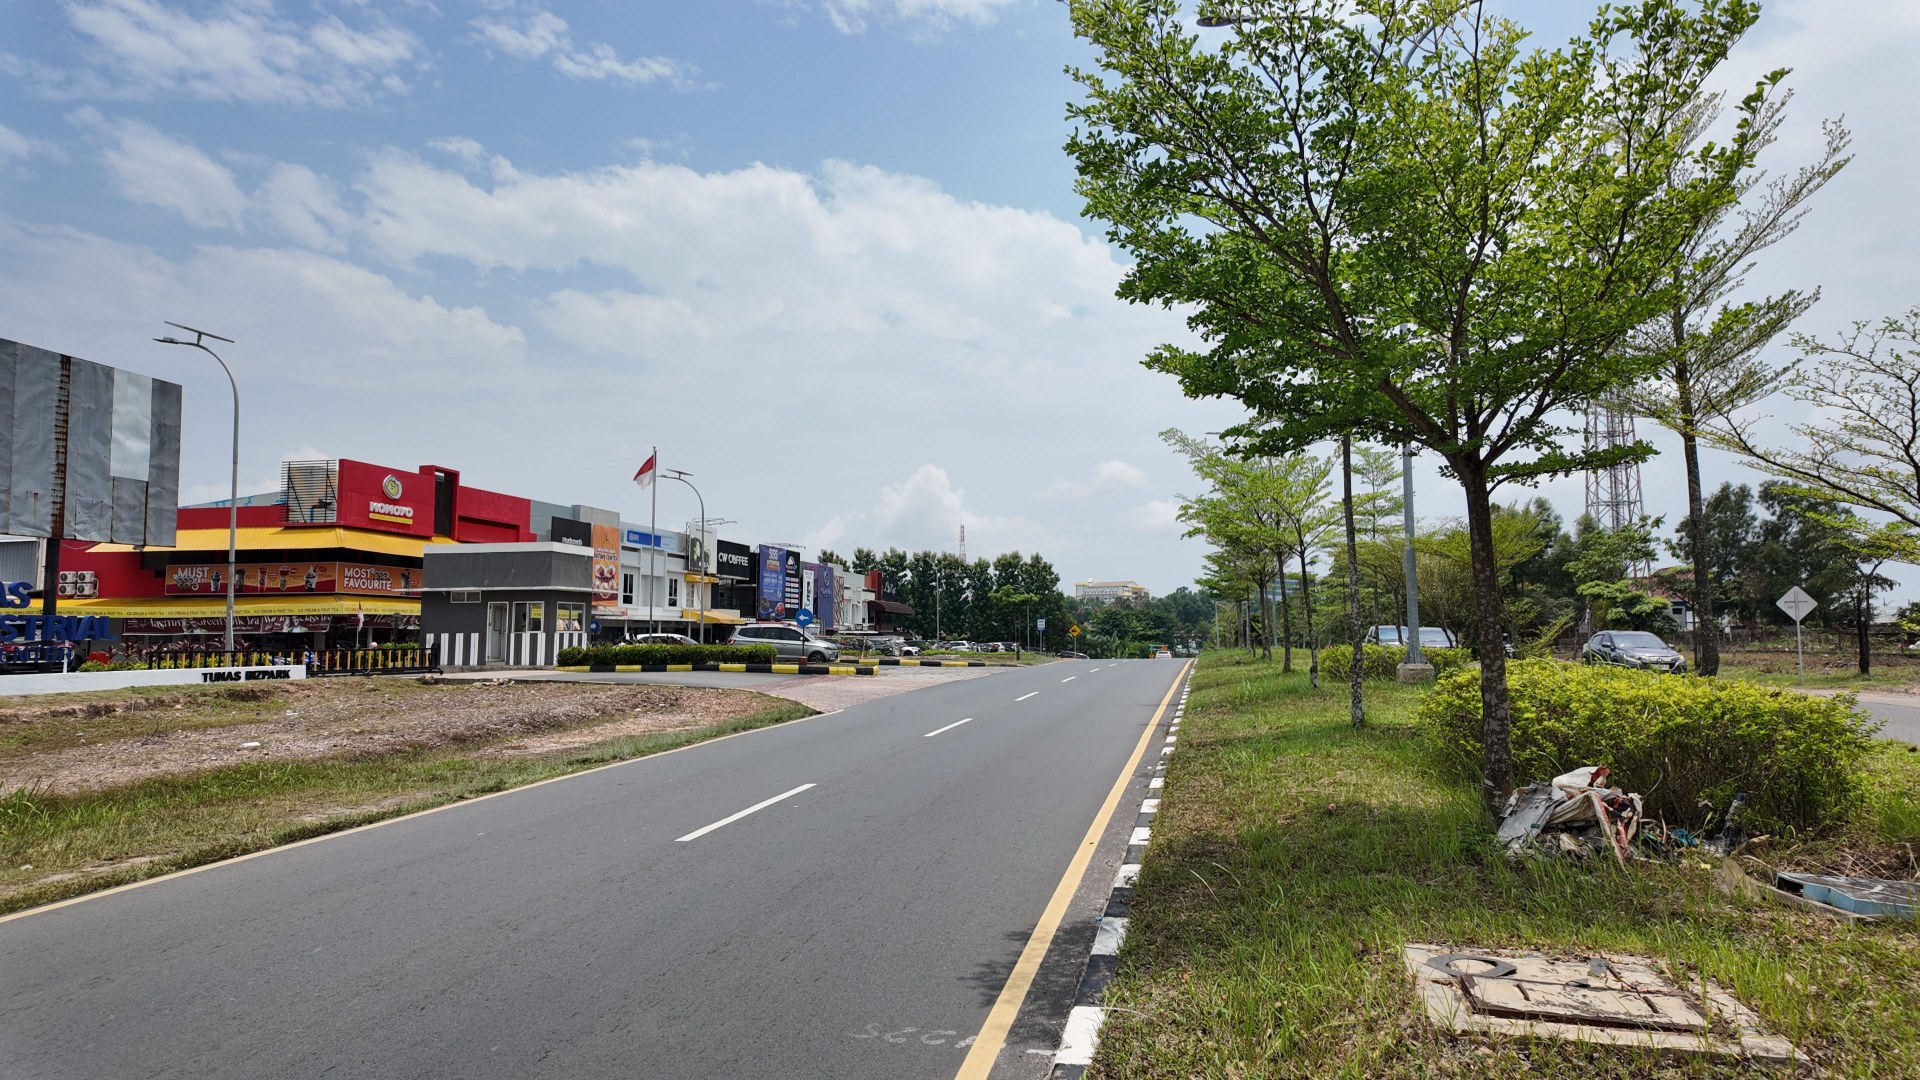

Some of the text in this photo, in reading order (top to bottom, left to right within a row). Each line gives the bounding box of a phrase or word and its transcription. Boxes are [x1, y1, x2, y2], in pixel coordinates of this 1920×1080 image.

[369, 501, 413, 517] MOMOYO
[718, 552, 749, 567] CW COFFEE
[178, 567, 209, 579] MUST
[344, 567, 371, 579] MOST
[343, 577, 392, 591] FAVOURITE
[202, 670, 291, 682] TUNAS BIZPARK
